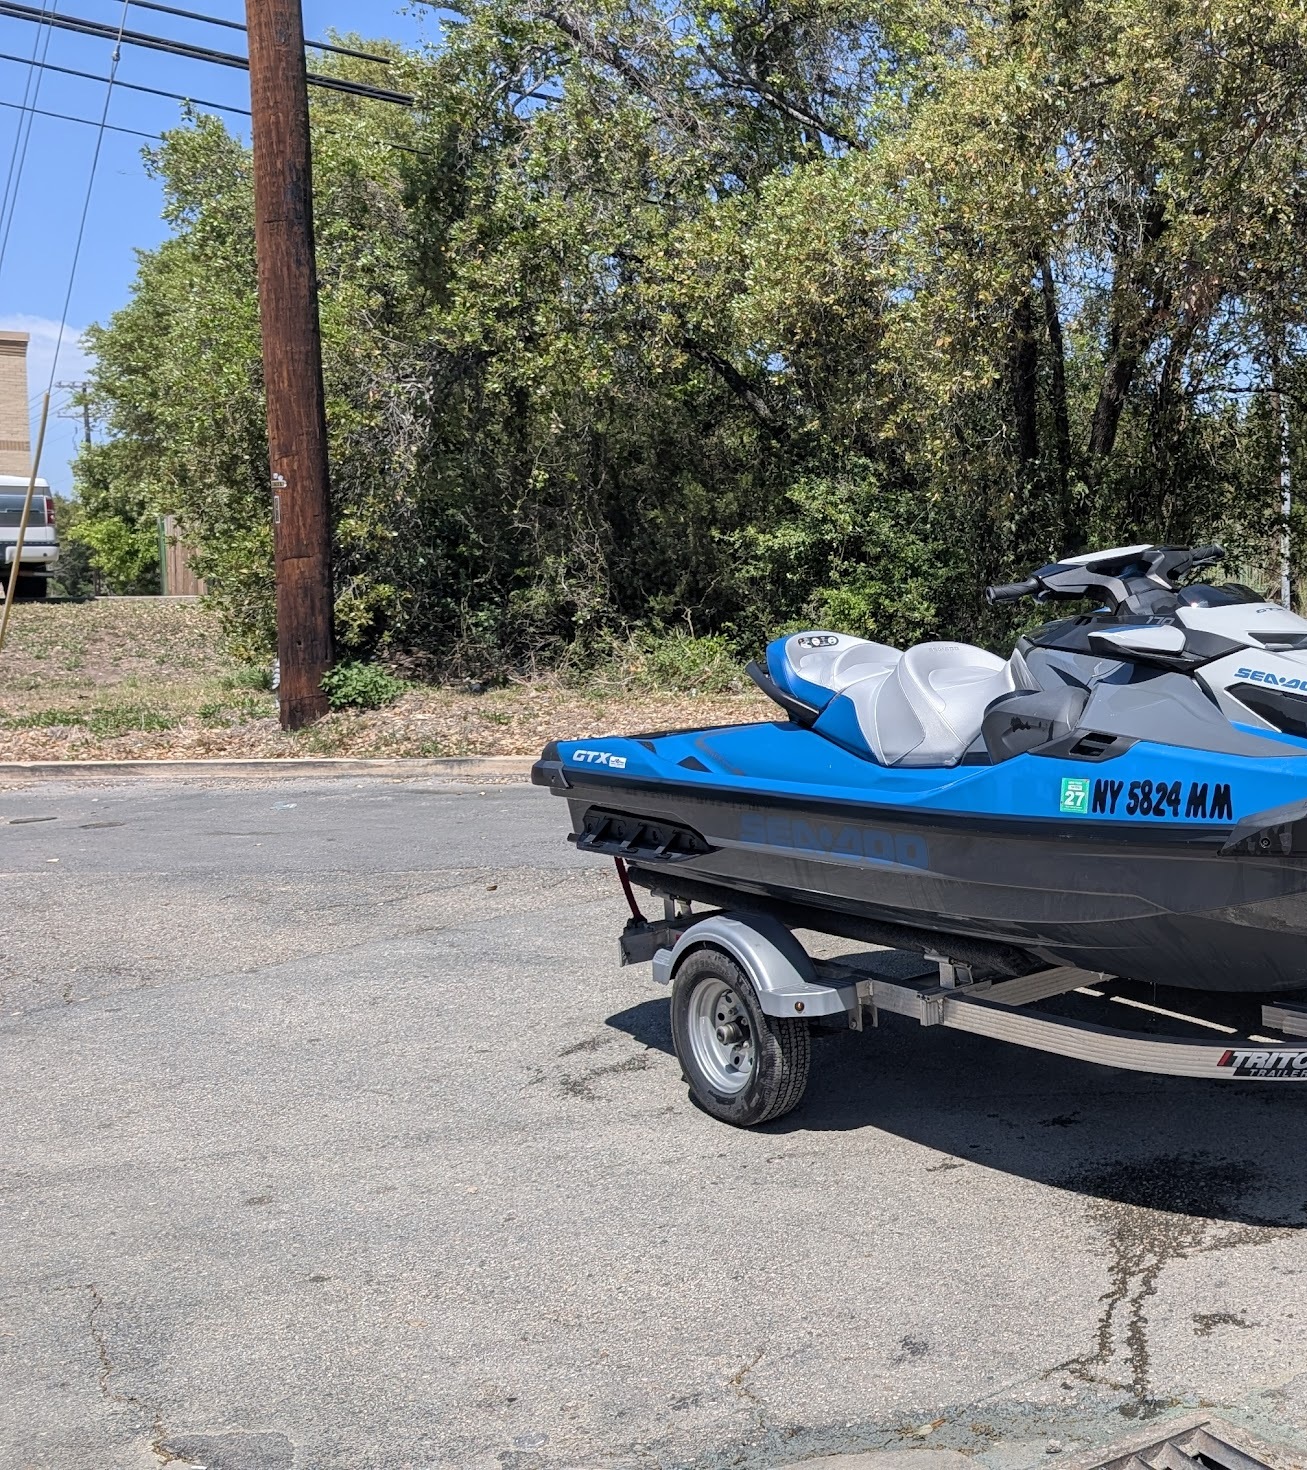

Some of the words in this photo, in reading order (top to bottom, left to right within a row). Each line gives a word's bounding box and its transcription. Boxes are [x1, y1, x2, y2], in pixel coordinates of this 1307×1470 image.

[1146, 615, 1175, 625] 170
[572, 750, 612, 764] GTX
[1064, 790, 1086, 807] 27
[1092, 778, 1124, 815] NY
[1126, 779, 1182, 818] 5824
[1185, 782, 1233, 820] MM
